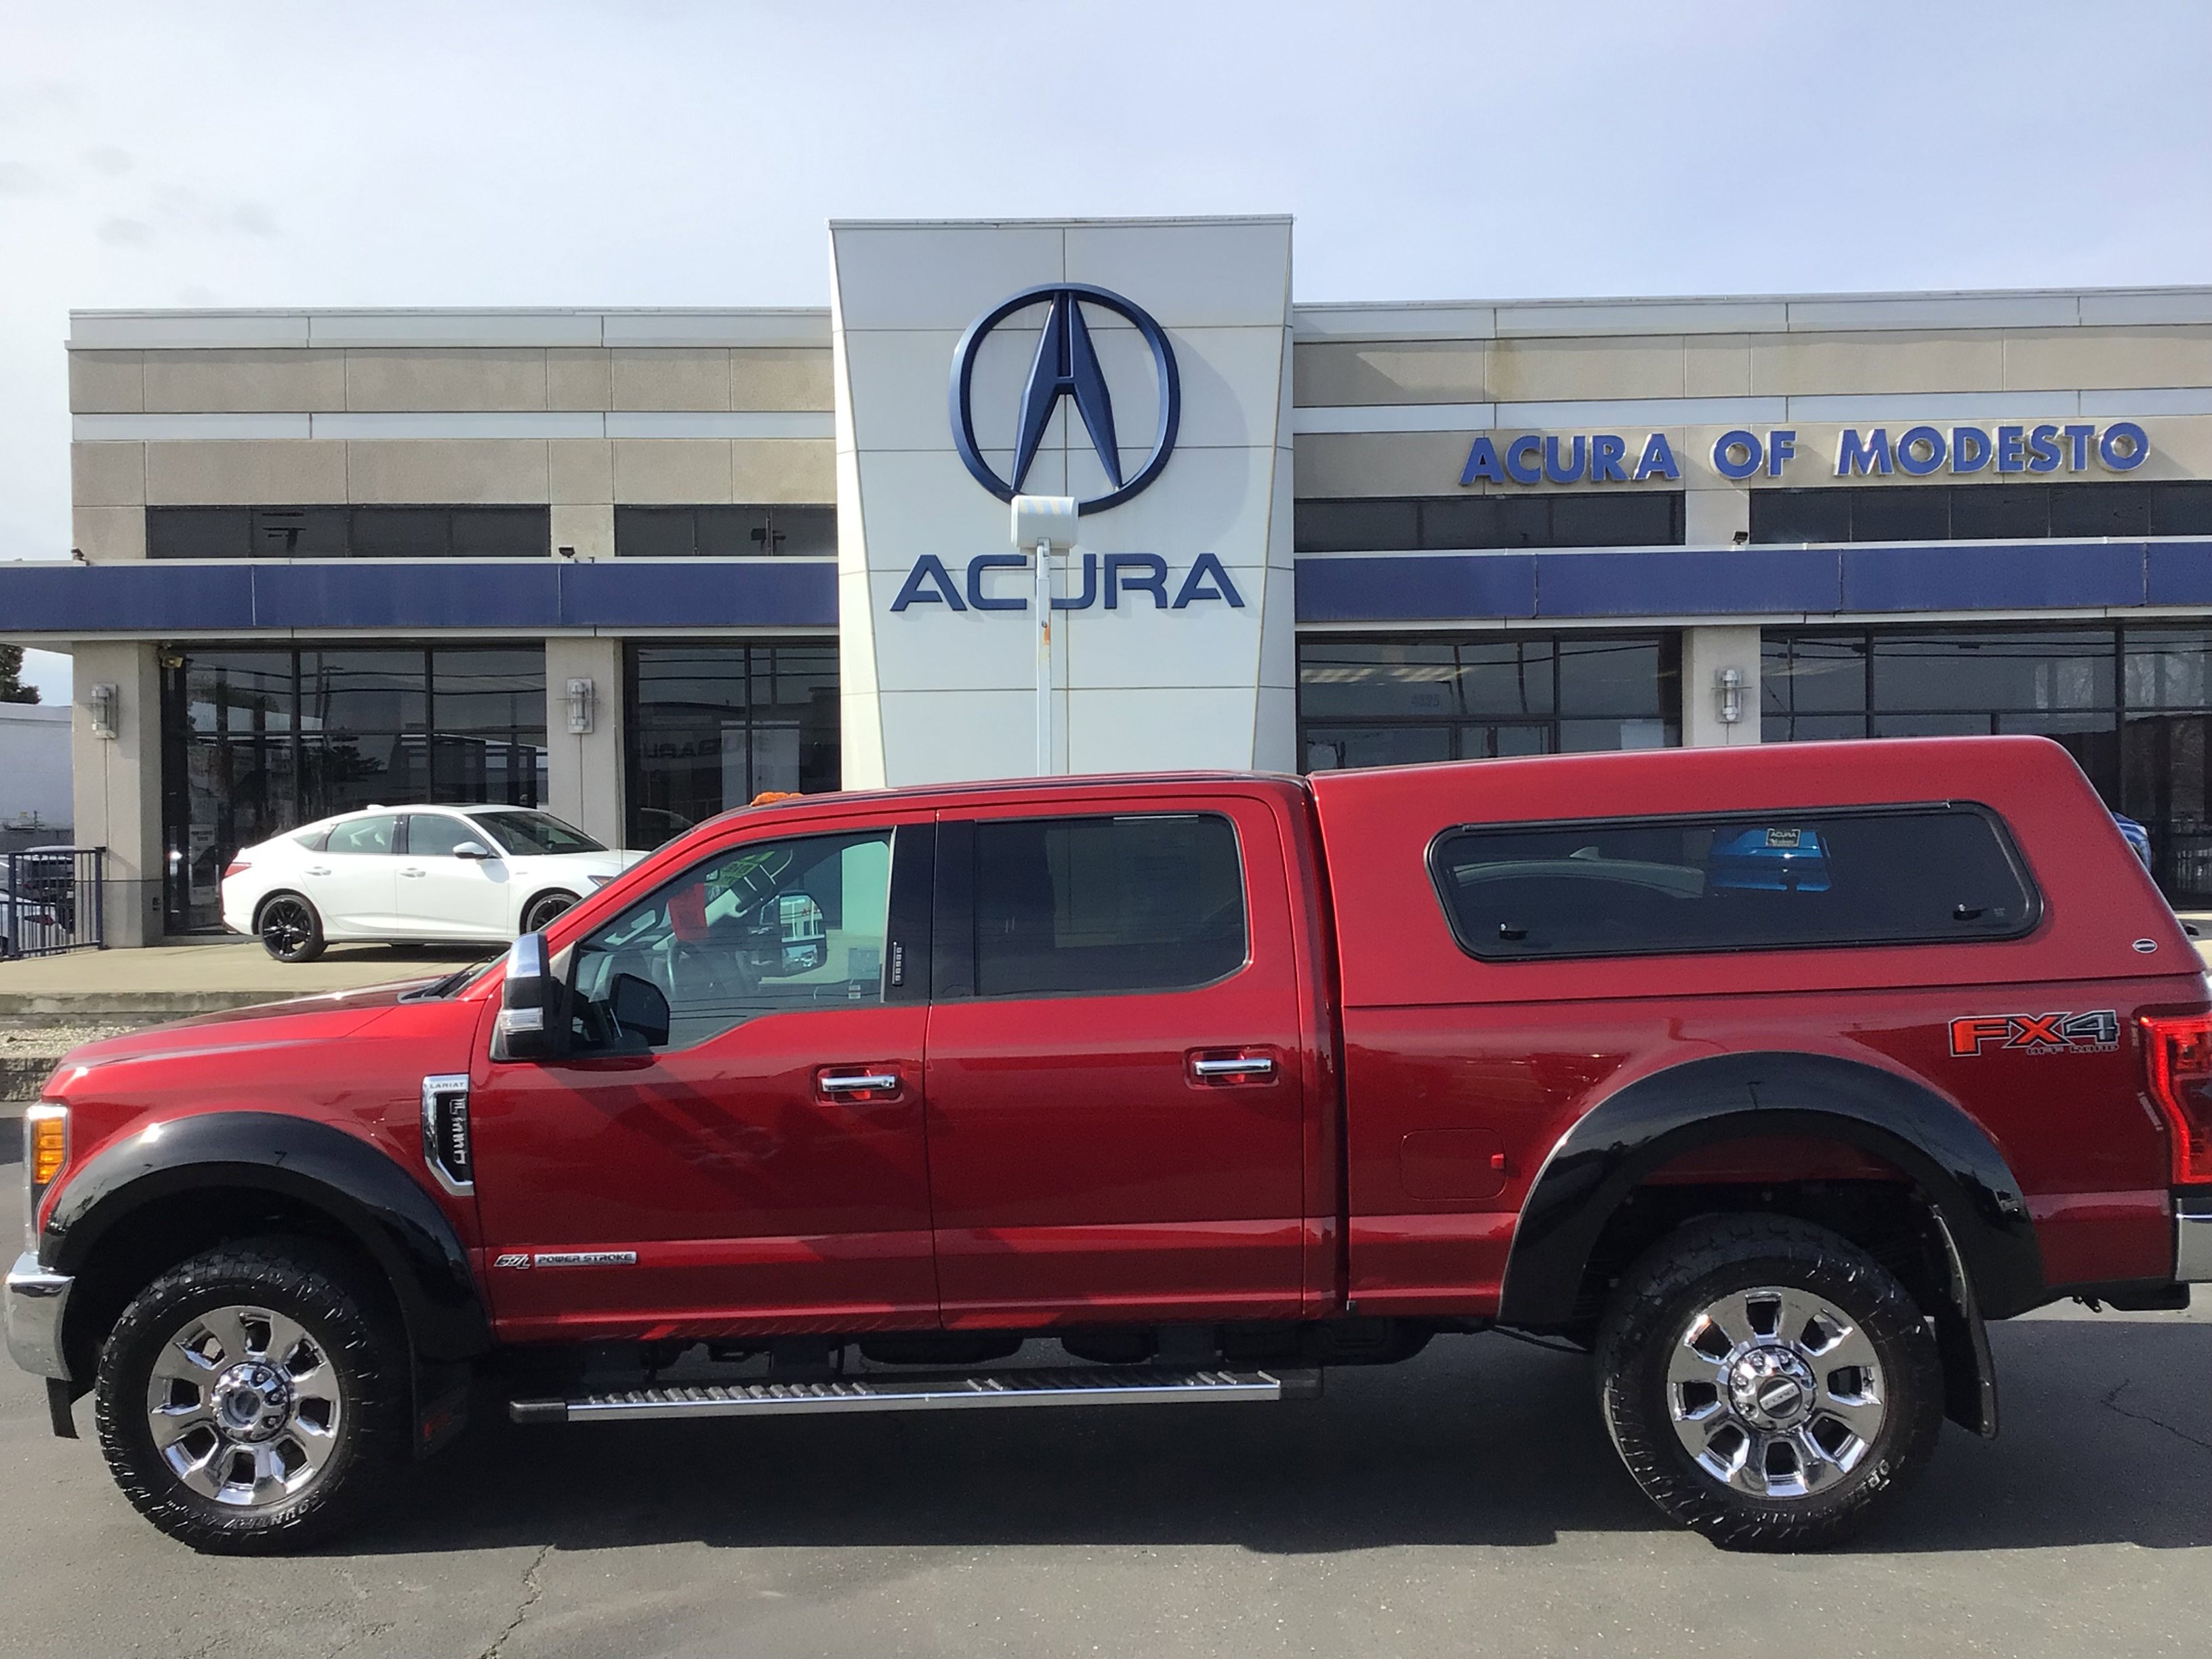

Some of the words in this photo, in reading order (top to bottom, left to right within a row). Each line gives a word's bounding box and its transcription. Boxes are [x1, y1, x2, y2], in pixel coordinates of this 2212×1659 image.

[1458, 431, 1681, 487] ACURA
[1712, 429, 1797, 480] OF
[1834, 421, 2150, 477] MODESTO
[889, 552, 1246, 612] ACURA
[1948, 1009, 2120, 1057] FX4
[538, 1255, 580, 1264] POWER
[583, 1253, 633, 1263] STROKE
